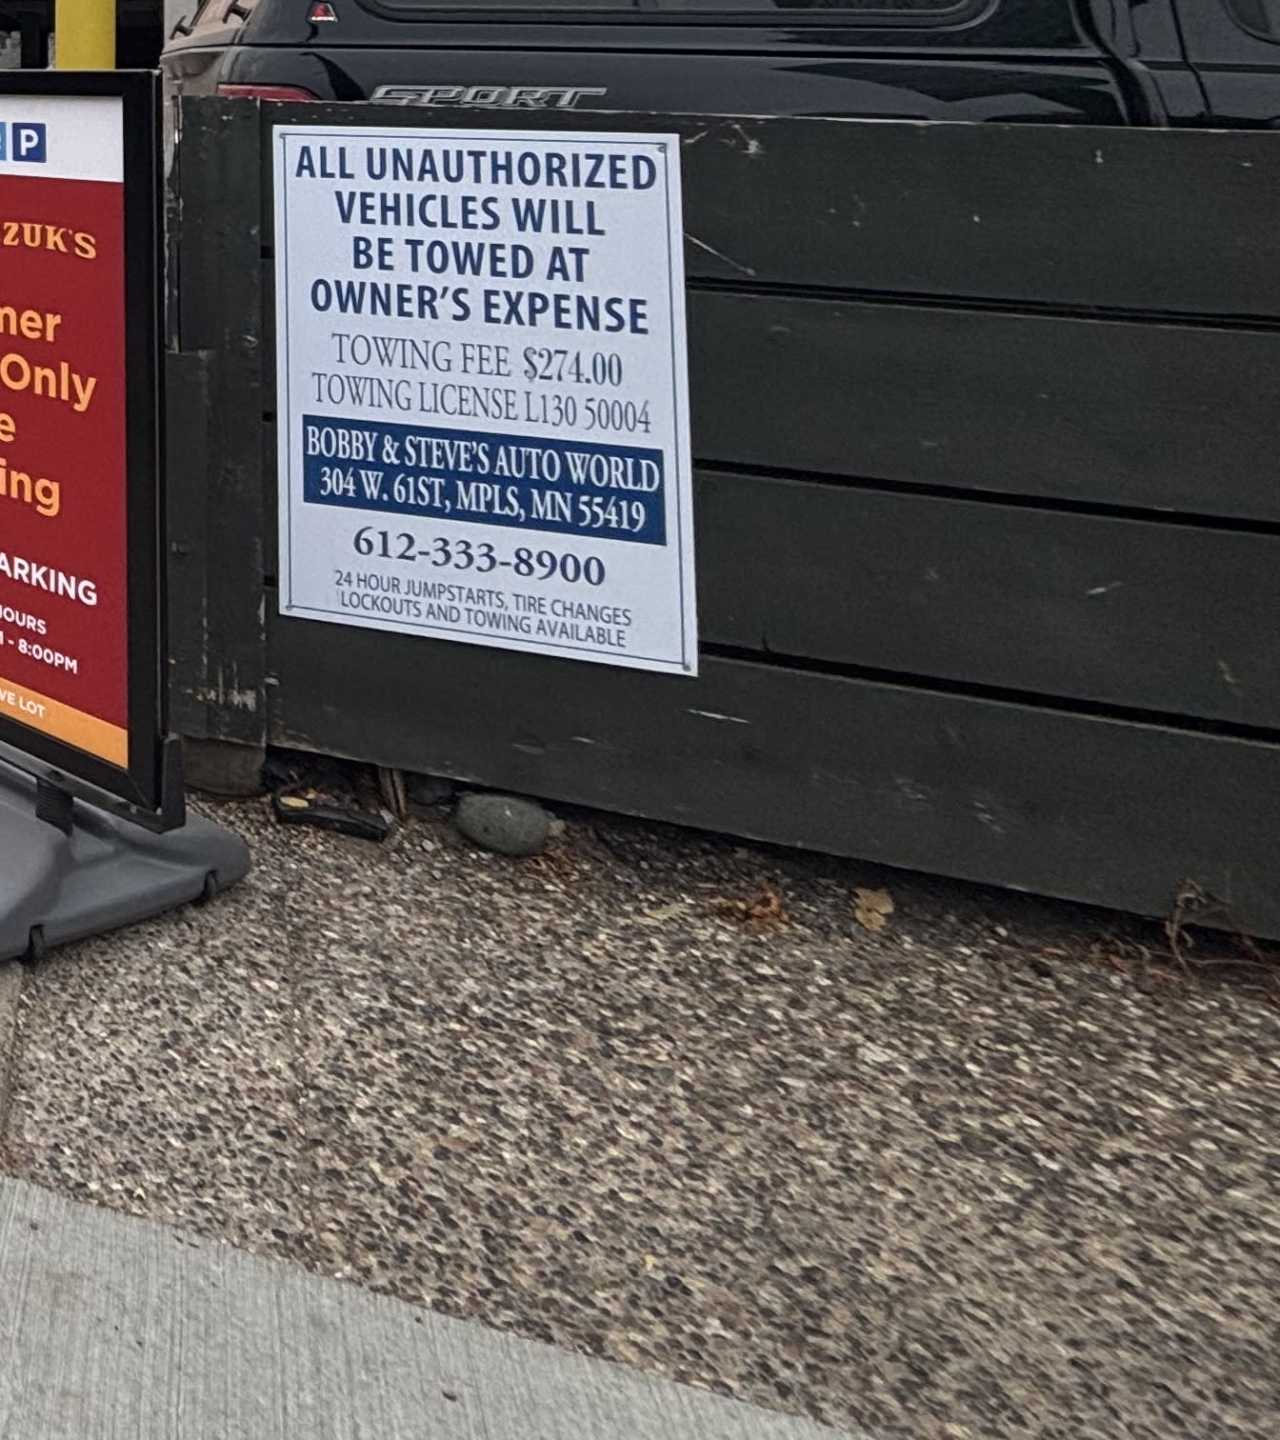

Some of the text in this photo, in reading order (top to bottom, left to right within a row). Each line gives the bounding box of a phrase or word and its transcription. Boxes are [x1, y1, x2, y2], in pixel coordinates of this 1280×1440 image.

[370, 84, 608, 108] SPORT
[295, 146, 657, 190] ALL UNAUTHORIZED
[335, 190, 605, 236] VEHICLES WILL
[353, 236, 590, 282] BE TOWED AT
[310, 278, 649, 335] OWNER'S EXPENSE
[0, 353, 97, 412] Only
[331, 332, 623, 387] TOWING FEE $274.00
[312, 372, 652, 434] TOWING LICENSE L130 50004
[306, 425, 660, 493] BOBBY & STEVE'S AUTO WORLD
[320, 467, 647, 533] 304 W. 61ST, MPLS, MN 55419
[352, 525, 606, 587] 612-333-8900
[335, 570, 632, 627] 24 HOUR JUMPSTARTS, TIRE CHANGES
[341, 590, 626, 648] LOCKOUTS AND TOWING AVAILABLE
[18, 638, 78, 674] 8:00PM
[19, 695, 46, 718] LOT
